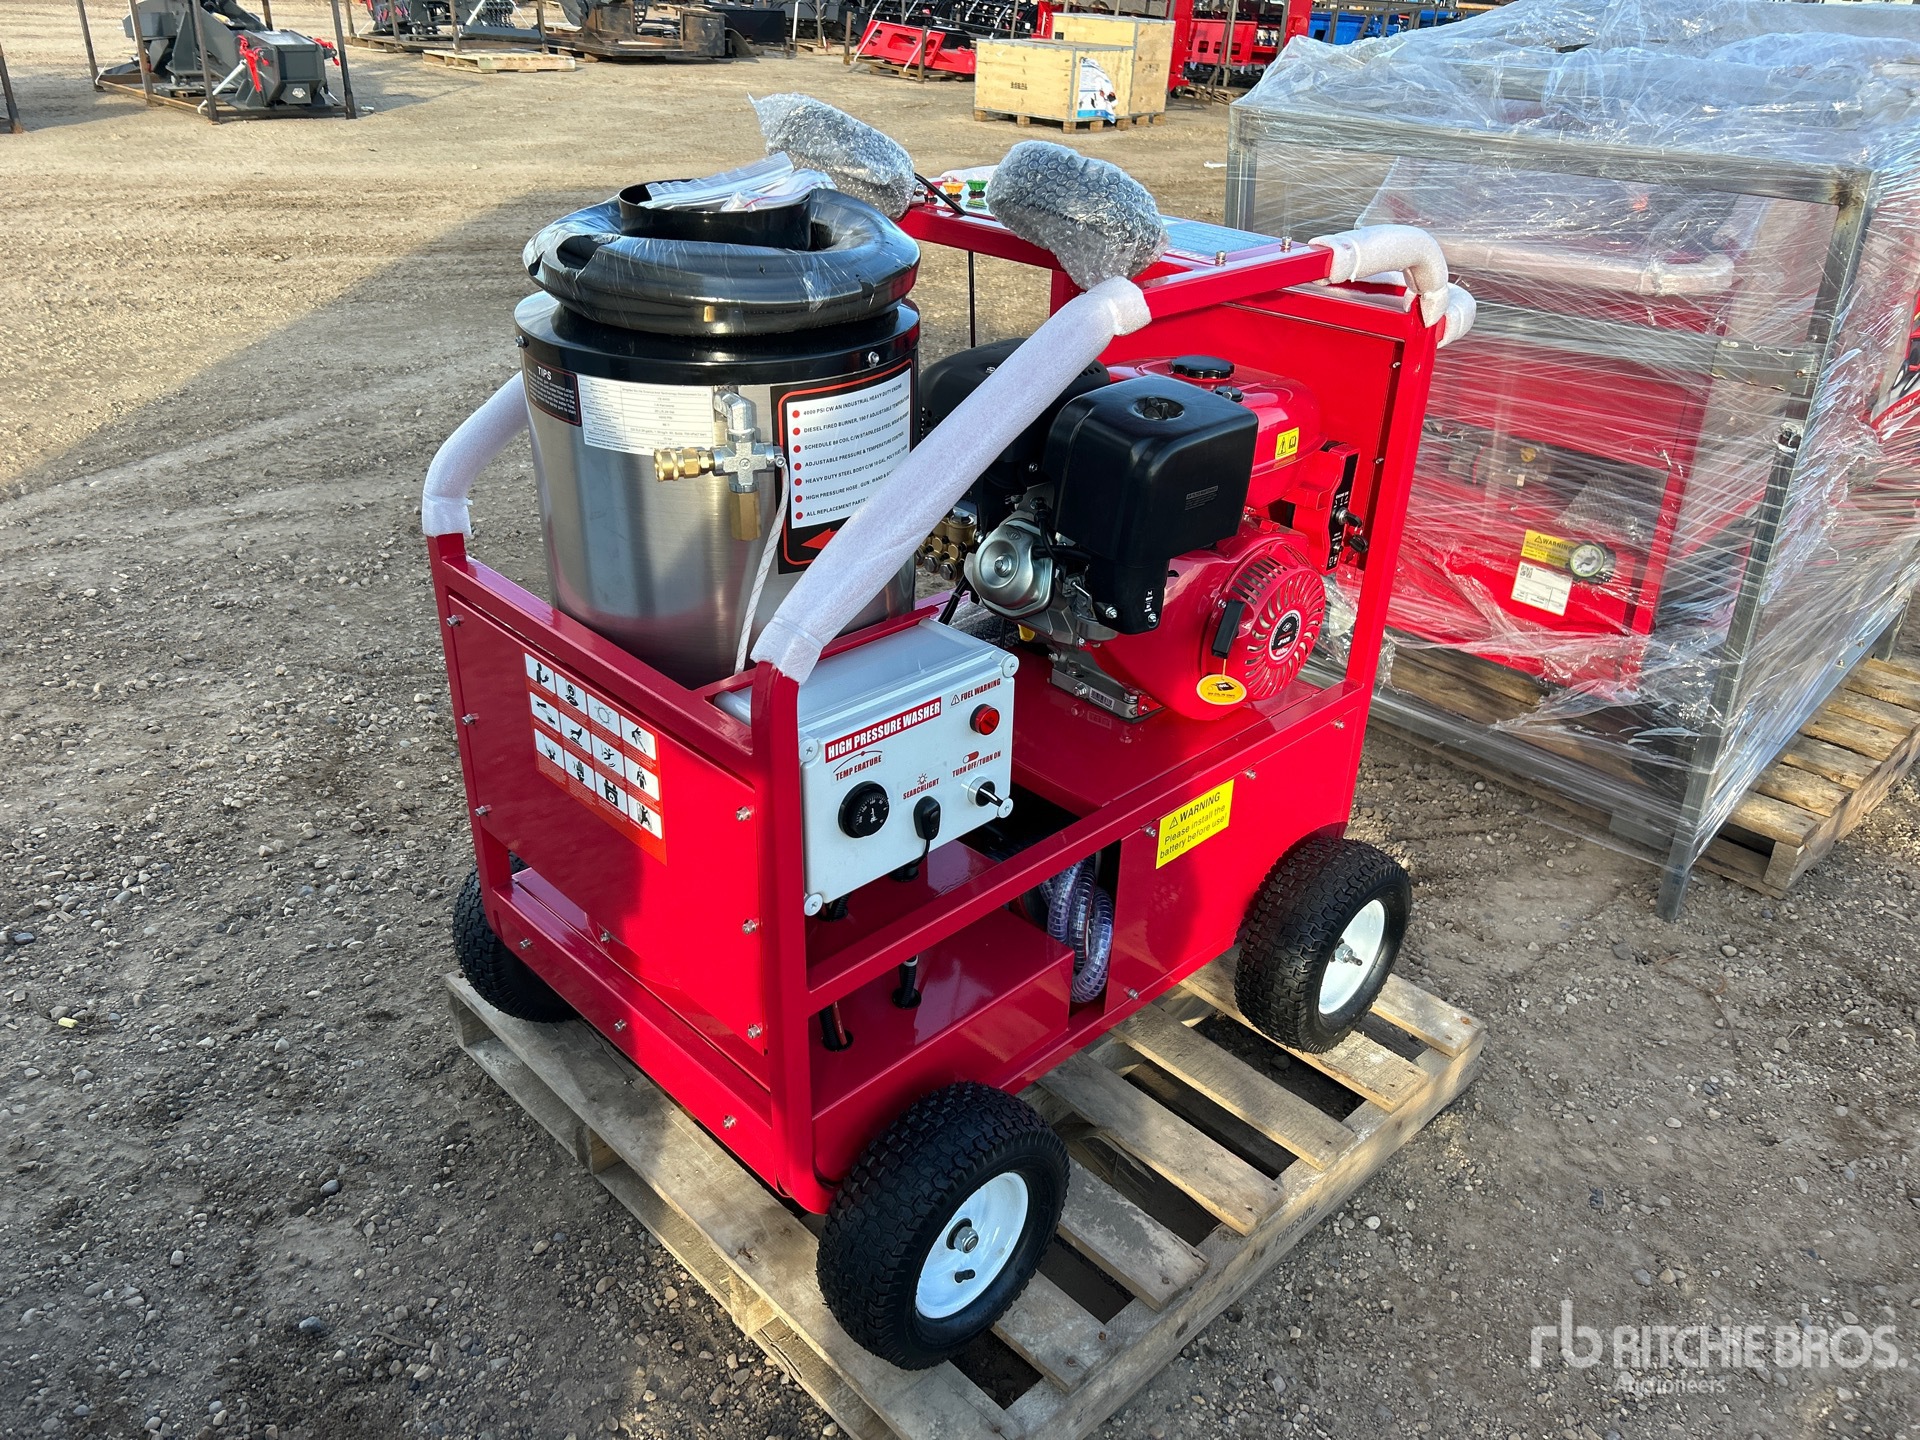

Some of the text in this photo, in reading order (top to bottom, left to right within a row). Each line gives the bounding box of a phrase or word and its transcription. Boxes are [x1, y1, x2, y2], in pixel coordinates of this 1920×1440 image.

[537, 366, 552, 380] TIPS
[843, 398, 869, 408] INDUSTRIAL
[869, 393, 882, 401] HEAVY
[870, 406, 891, 418] ADJUSTABLE
[804, 441, 832, 450] SCHEDULE
[860, 427, 881, 438] STAINLESS
[805, 457, 838, 467] ADJUSTABLE
[839, 450, 862, 460] PRESSURE
[866, 439, 892, 451] TEMPERATURE
[806, 476, 824, 484] HEAVY
[838, 470, 852, 478] STEEL
[820, 488, 845, 497] PRESSURE
[817, 502, 851, 514] REPLACEMENT
[852, 498, 866, 506] PARTS
[961, 678, 1000, 701] FUEL WARNING
[828, 702, 940, 759] HIGH PRESSURE WASHER
[952, 766, 966, 777] TURN
[994, 750, 1001, 759] ON
[903, 778, 939, 800] SEARCHLIGHT
[1180, 792, 1220, 822] WARNING
[1160, 813, 1227, 859] battery before use!
[1165, 805, 1226, 845] Please install the
